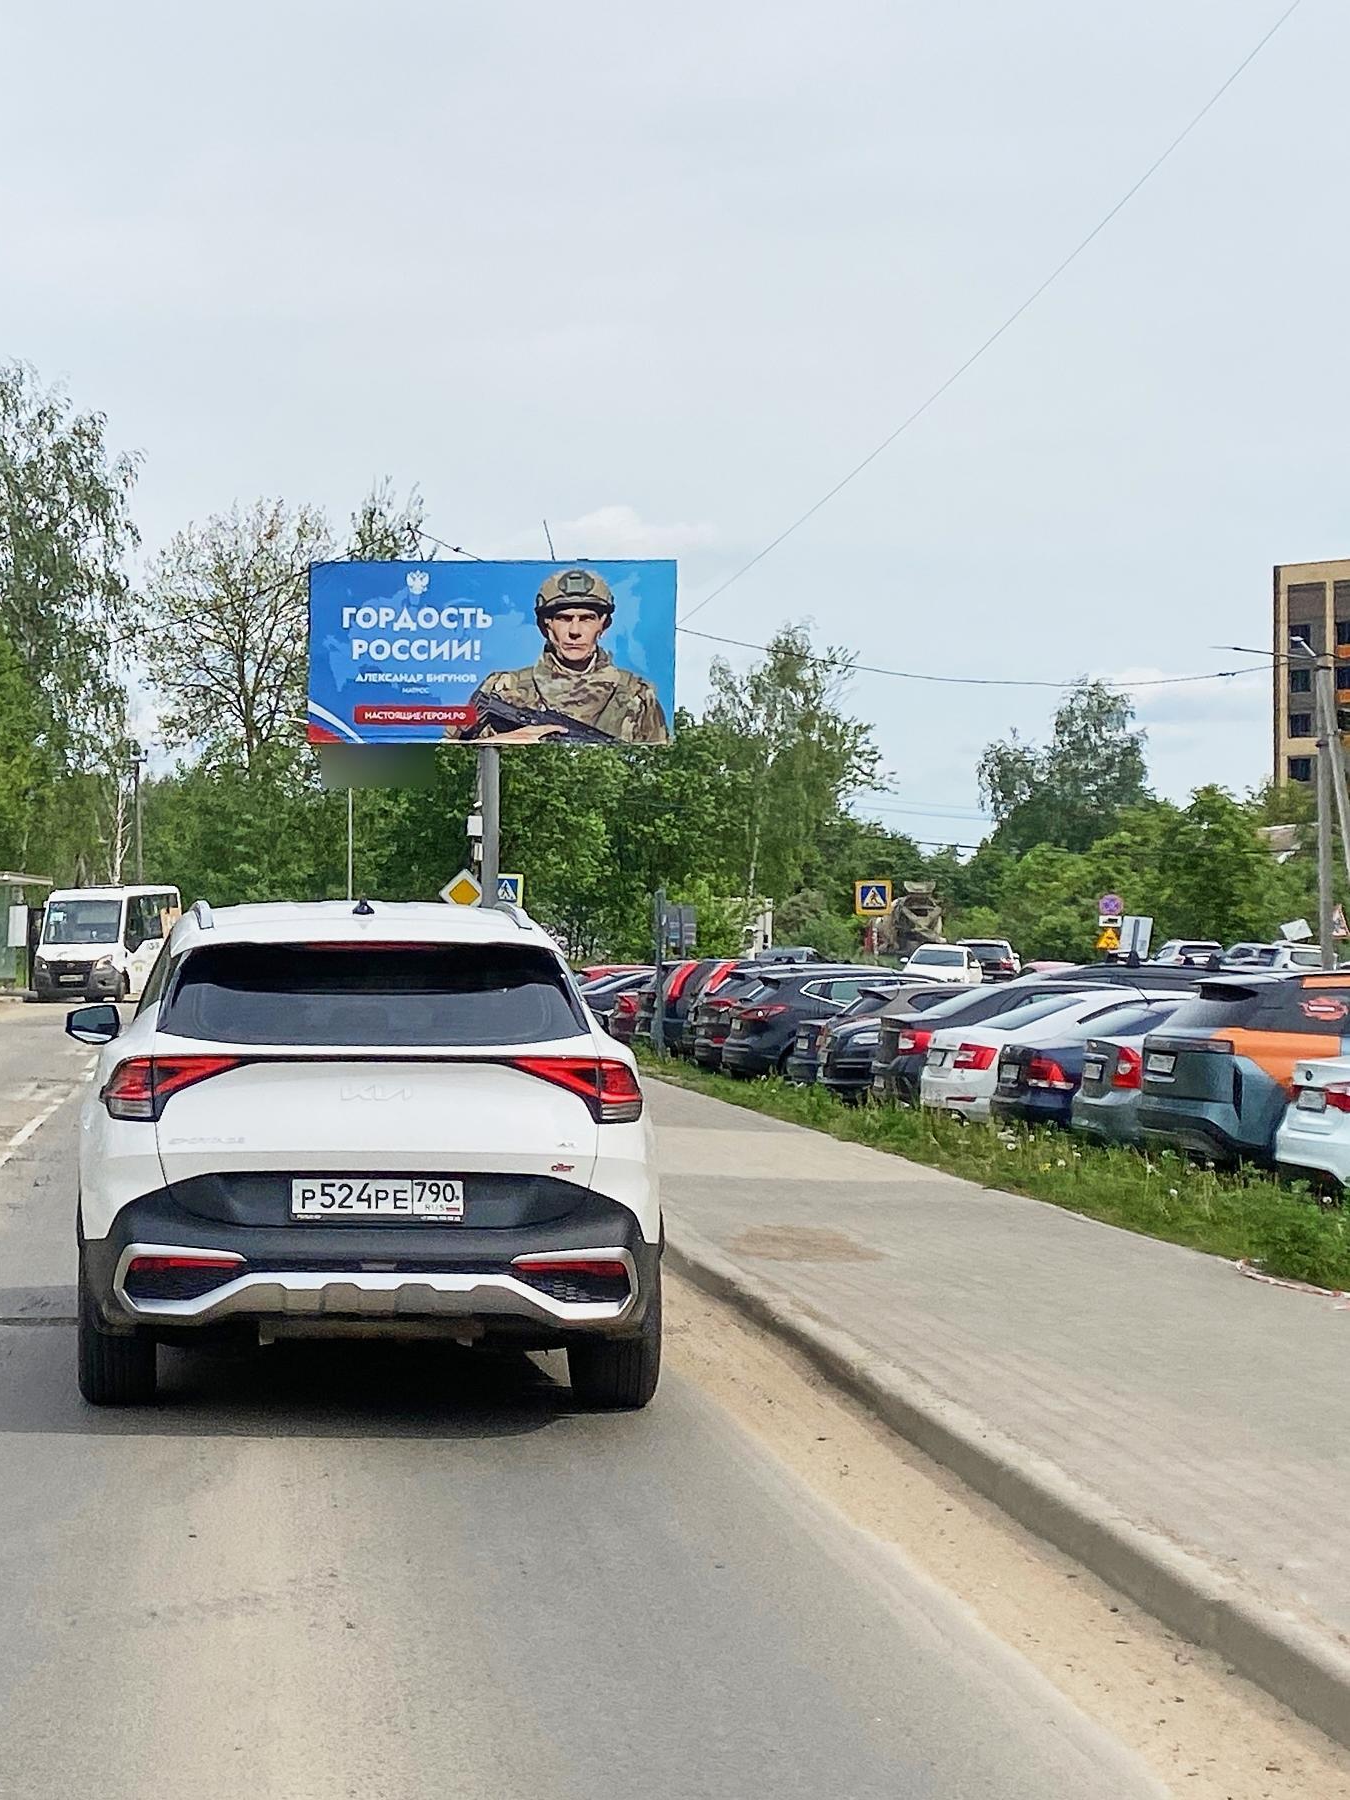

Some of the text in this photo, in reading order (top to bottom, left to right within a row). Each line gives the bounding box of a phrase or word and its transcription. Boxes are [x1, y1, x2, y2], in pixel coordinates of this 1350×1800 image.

[342, 606, 493, 631] ГОРДОСТЬ
[352, 638, 481, 661] РОССИИ!
[355, 673, 424, 684] АЛЕКСАНДР
[414, 1181, 456, 1203] 790
